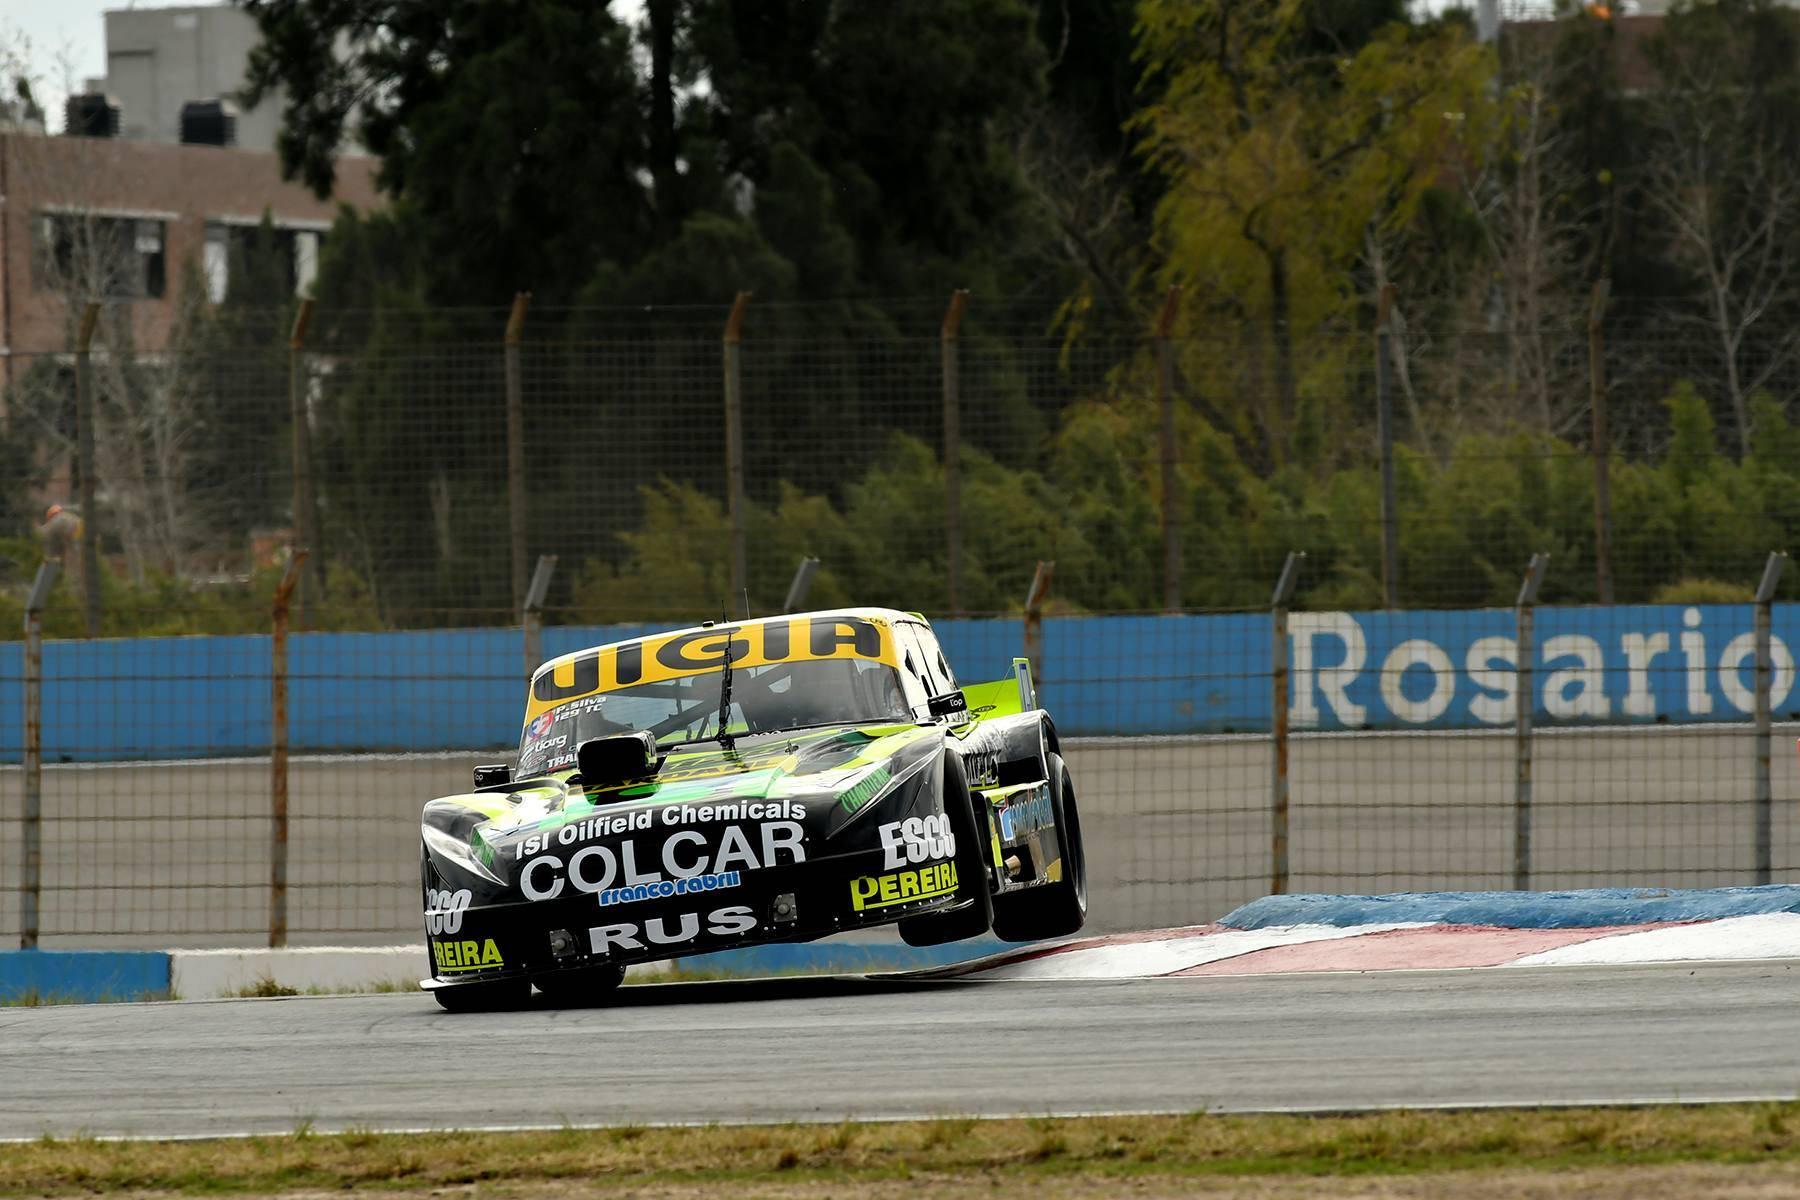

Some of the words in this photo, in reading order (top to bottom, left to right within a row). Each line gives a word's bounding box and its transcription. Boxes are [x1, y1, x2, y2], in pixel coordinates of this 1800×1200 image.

[1287, 607, 1796, 727] Rosario
[555, 708, 580, 722] 129
[586, 703, 603, 713] TC
[516, 832, 549, 860] ISI
[558, 809, 652, 845] Oilfield
[661, 800, 806, 827] Chemicals
[878, 813, 956, 871] ESCO
[520, 821, 806, 901] COLCAR
[850, 861, 959, 911] PEREIRA
[424, 887, 473, 936] SCO
[589, 906, 757, 954] RUS
